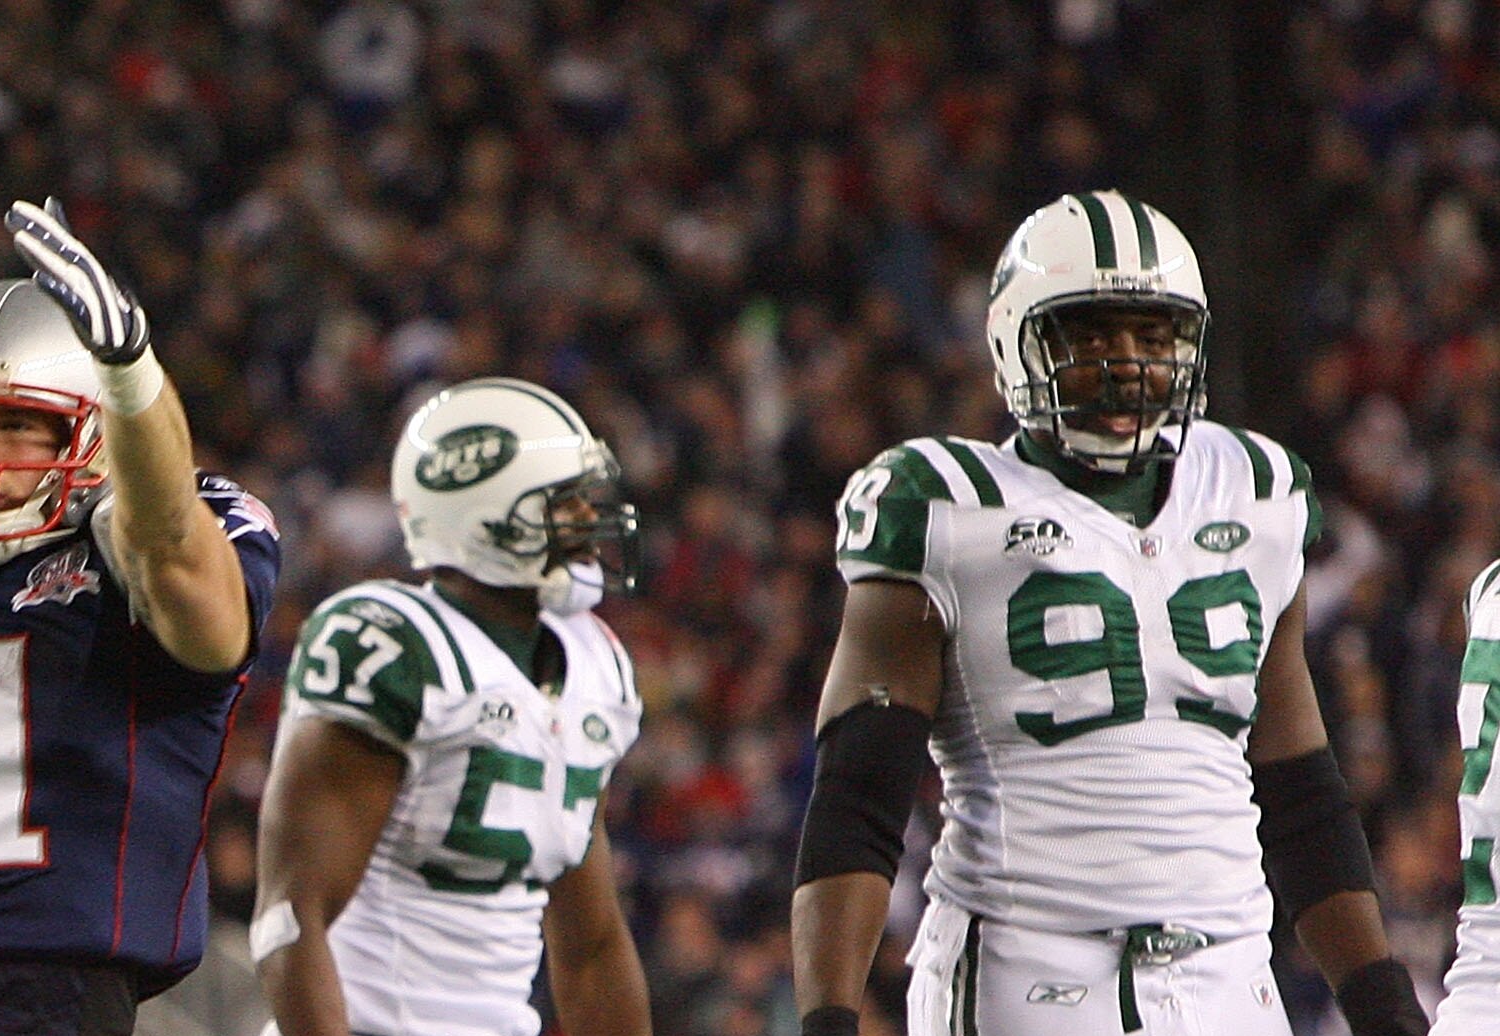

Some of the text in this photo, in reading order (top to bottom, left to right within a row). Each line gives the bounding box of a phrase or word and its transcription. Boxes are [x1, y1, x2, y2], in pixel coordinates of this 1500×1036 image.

[303, 613, 404, 704] 57
[1006, 568, 1263, 747] 99
[415, 745, 601, 896] 57
